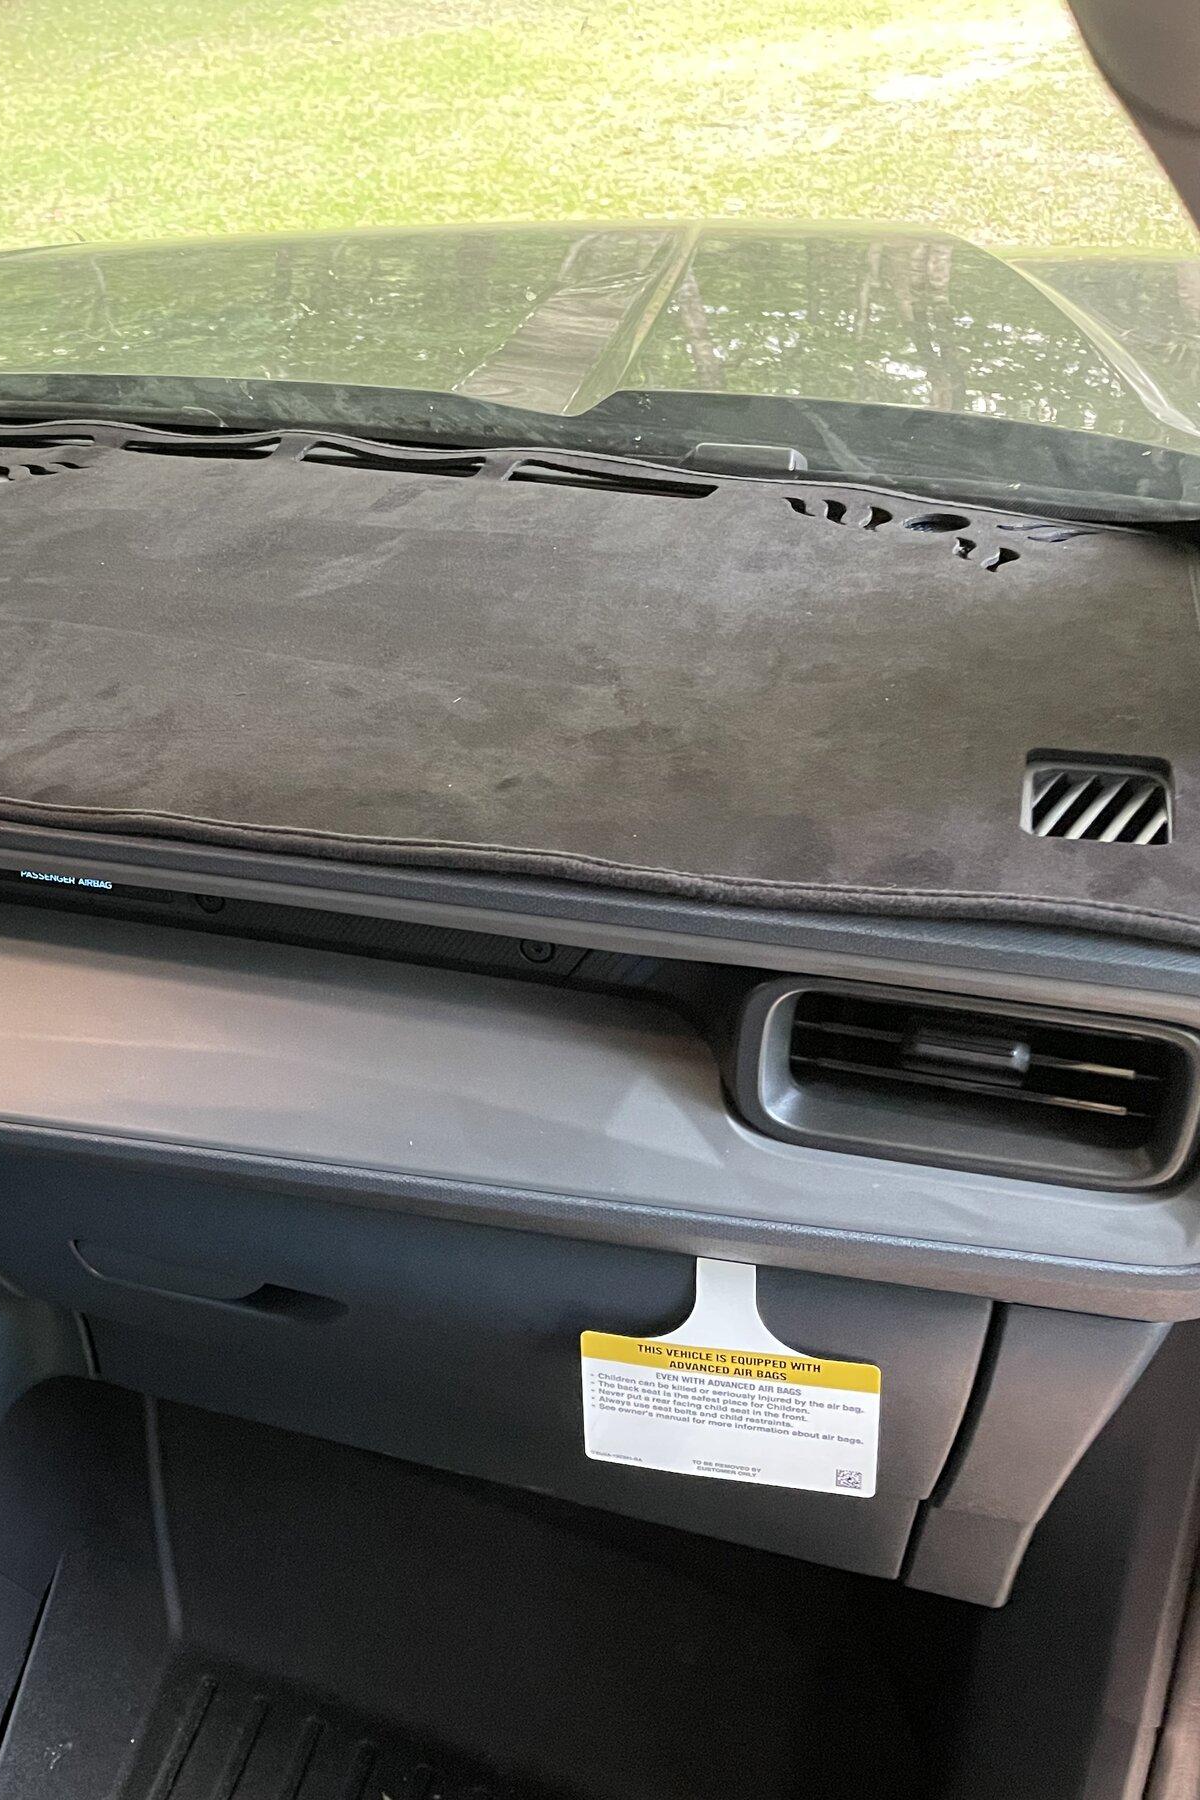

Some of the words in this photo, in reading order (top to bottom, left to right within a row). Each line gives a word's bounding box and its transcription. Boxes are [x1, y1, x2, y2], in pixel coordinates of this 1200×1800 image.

[20, 870, 75, 885] PASSENGER
[78, 878, 113, 890] AIRBAG
[638, 1344, 662, 1355] THIS
[666, 1348, 712, 1361] VEHICLE
[716, 1354, 726, 1363] IS
[731, 1355, 787, 1369] EQUIPPED
[791, 1362, 821, 1373] WITH
[669, 1361, 730, 1375] ADVANCED
[734, 1368, 753, 1377] AIR
[757, 1370, 787, 1381] BAGS
[598, 1372, 636, 1384] Children
[657, 1382, 670, 1390] be
[672, 1384, 697, 1393] killed
[712, 1390, 756, 1400] seriously
[758, 1394, 792, 1404] injured
[794, 1399, 807, 1407] by
[809, 1400, 824, 1409] the
[842, 1404, 864, 1414] bag.
[598, 1380, 616, 1388] The
[617, 1383, 639, 1392] back
[641, 1388, 661, 1396] seat
[674, 1392, 689, 1400] the
[691, 1395, 720, 1404] safest
[722, 1398, 749, 1407] place
[751, 1401, 764, 1409] for
[766, 1403, 810, 1414] Children.
[655, 1372, 679, 1382] EVEN
[681, 1375, 705, 1385] WITH
[708, 1379, 756, 1391] ADVANCED
[758, 1385, 774, 1393] AIR
[777, 1386, 802, 1396] BAGS
[598, 1388, 625, 1397] Never
[627, 1393, 642, 1401] put
[672, 1399, 702, 1410] facing
[705, 1404, 728, 1412] child
[730, 1407, 750, 1415] seat
[782, 1412, 807, 1422] front.
[598, 1396, 631, 1406] Always
[674, 1407, 697, 1416] belts
[699, 1411, 718, 1419] and
[720, 1413, 743, 1422] child
[745, 1416, 794, 1428] restraints.
[599, 1403, 616, 1411] See
[618, 1407, 653, 1417] owner's
[656, 1413, 690, 1422] manual
[708, 1420, 733, 1428] more
[735, 1422, 789, 1435] information
[792, 1430, 820, 1439] about
[837, 1435, 864, 1445] bags.
